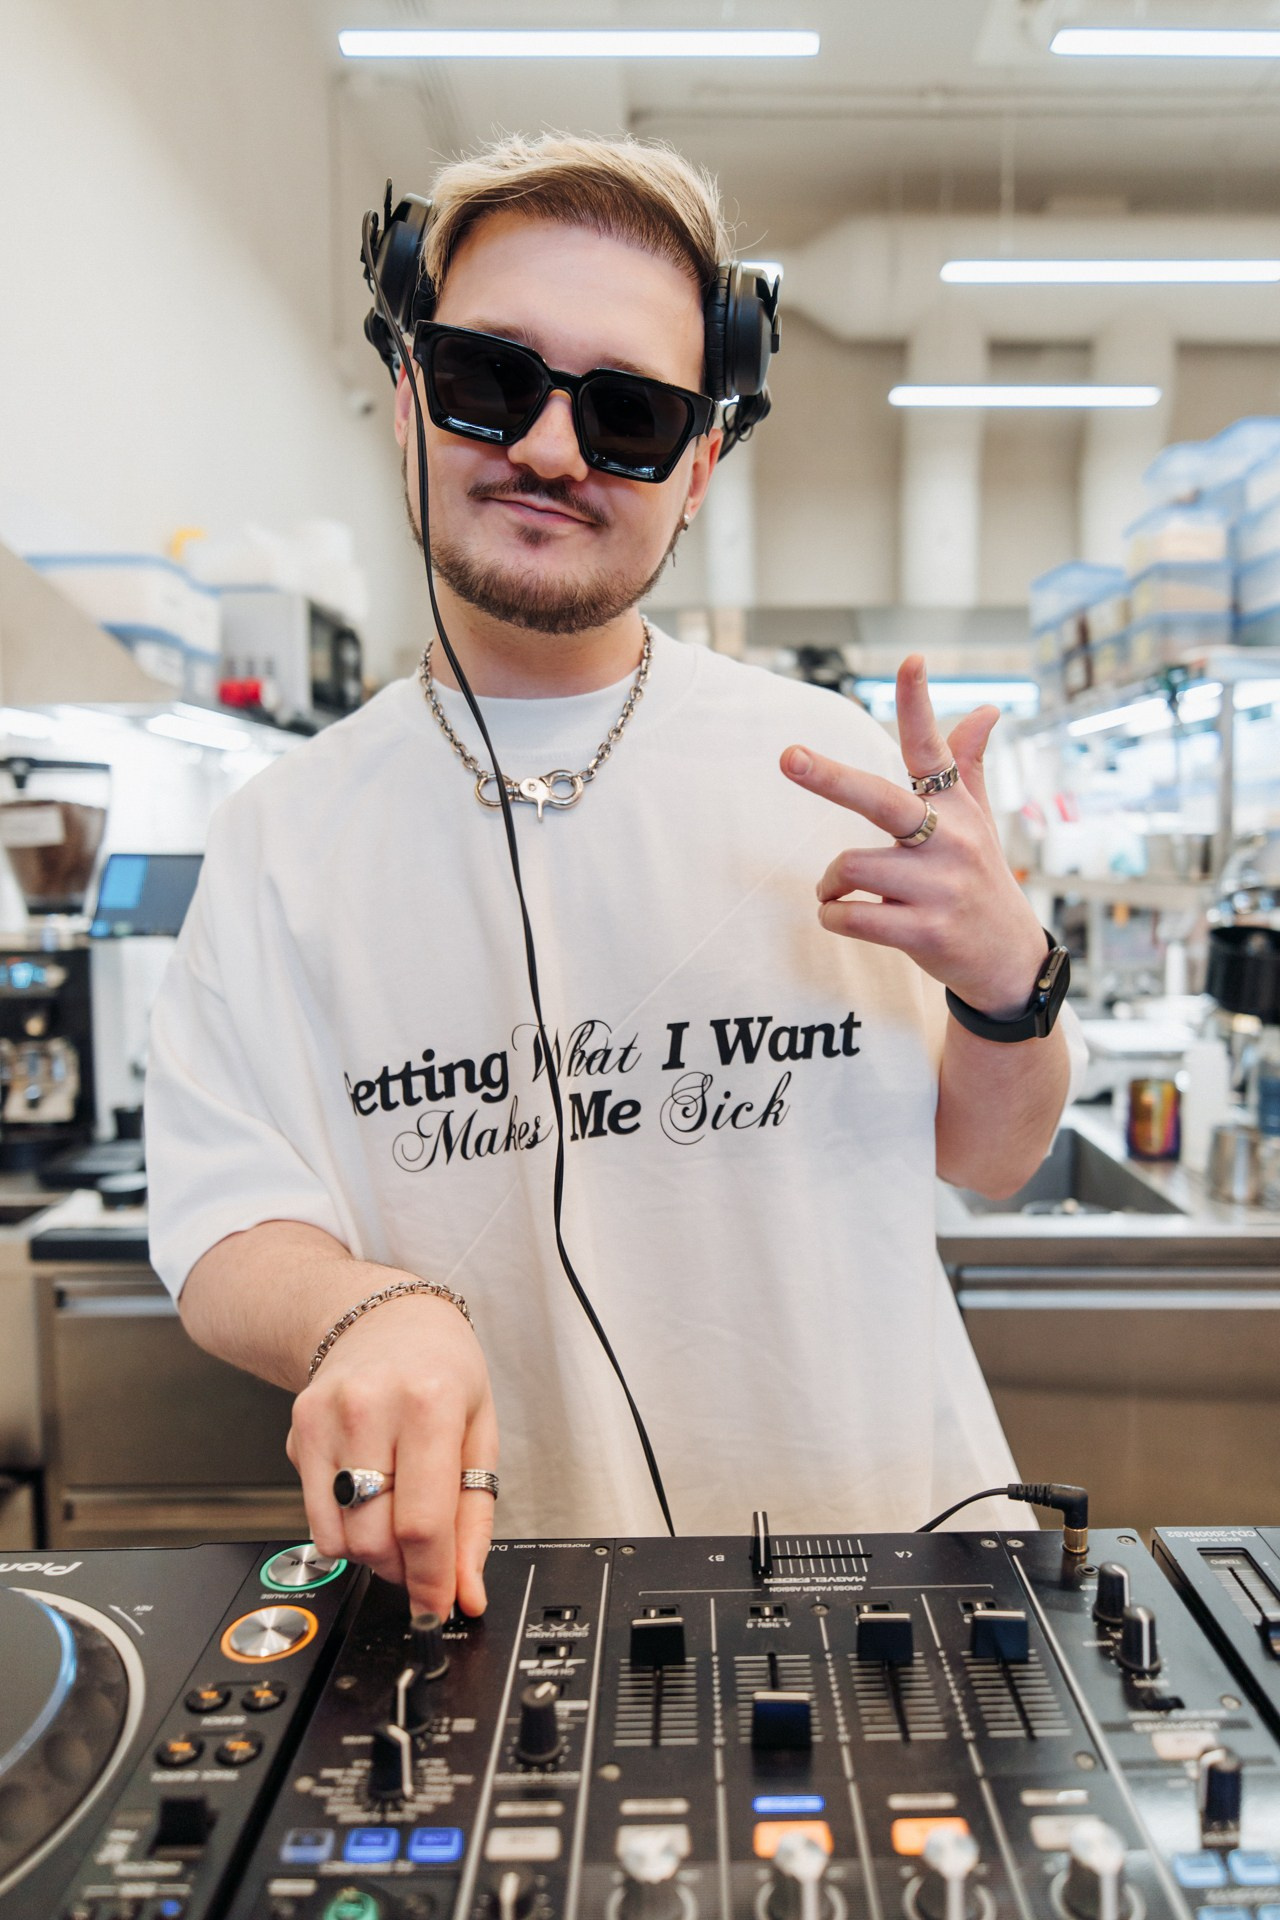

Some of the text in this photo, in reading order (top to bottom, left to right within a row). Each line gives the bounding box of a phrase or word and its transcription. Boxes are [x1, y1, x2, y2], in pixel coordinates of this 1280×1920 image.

[511, 1019, 643, 1083] What
[661, 1022, 690, 1071] I
[709, 1011, 862, 1066] Want
[392, 1071, 792, 1173] Makes Me Sick
[488, 1544, 508, 1552] DJ
[832, 1584, 864, 1592] CROSS
